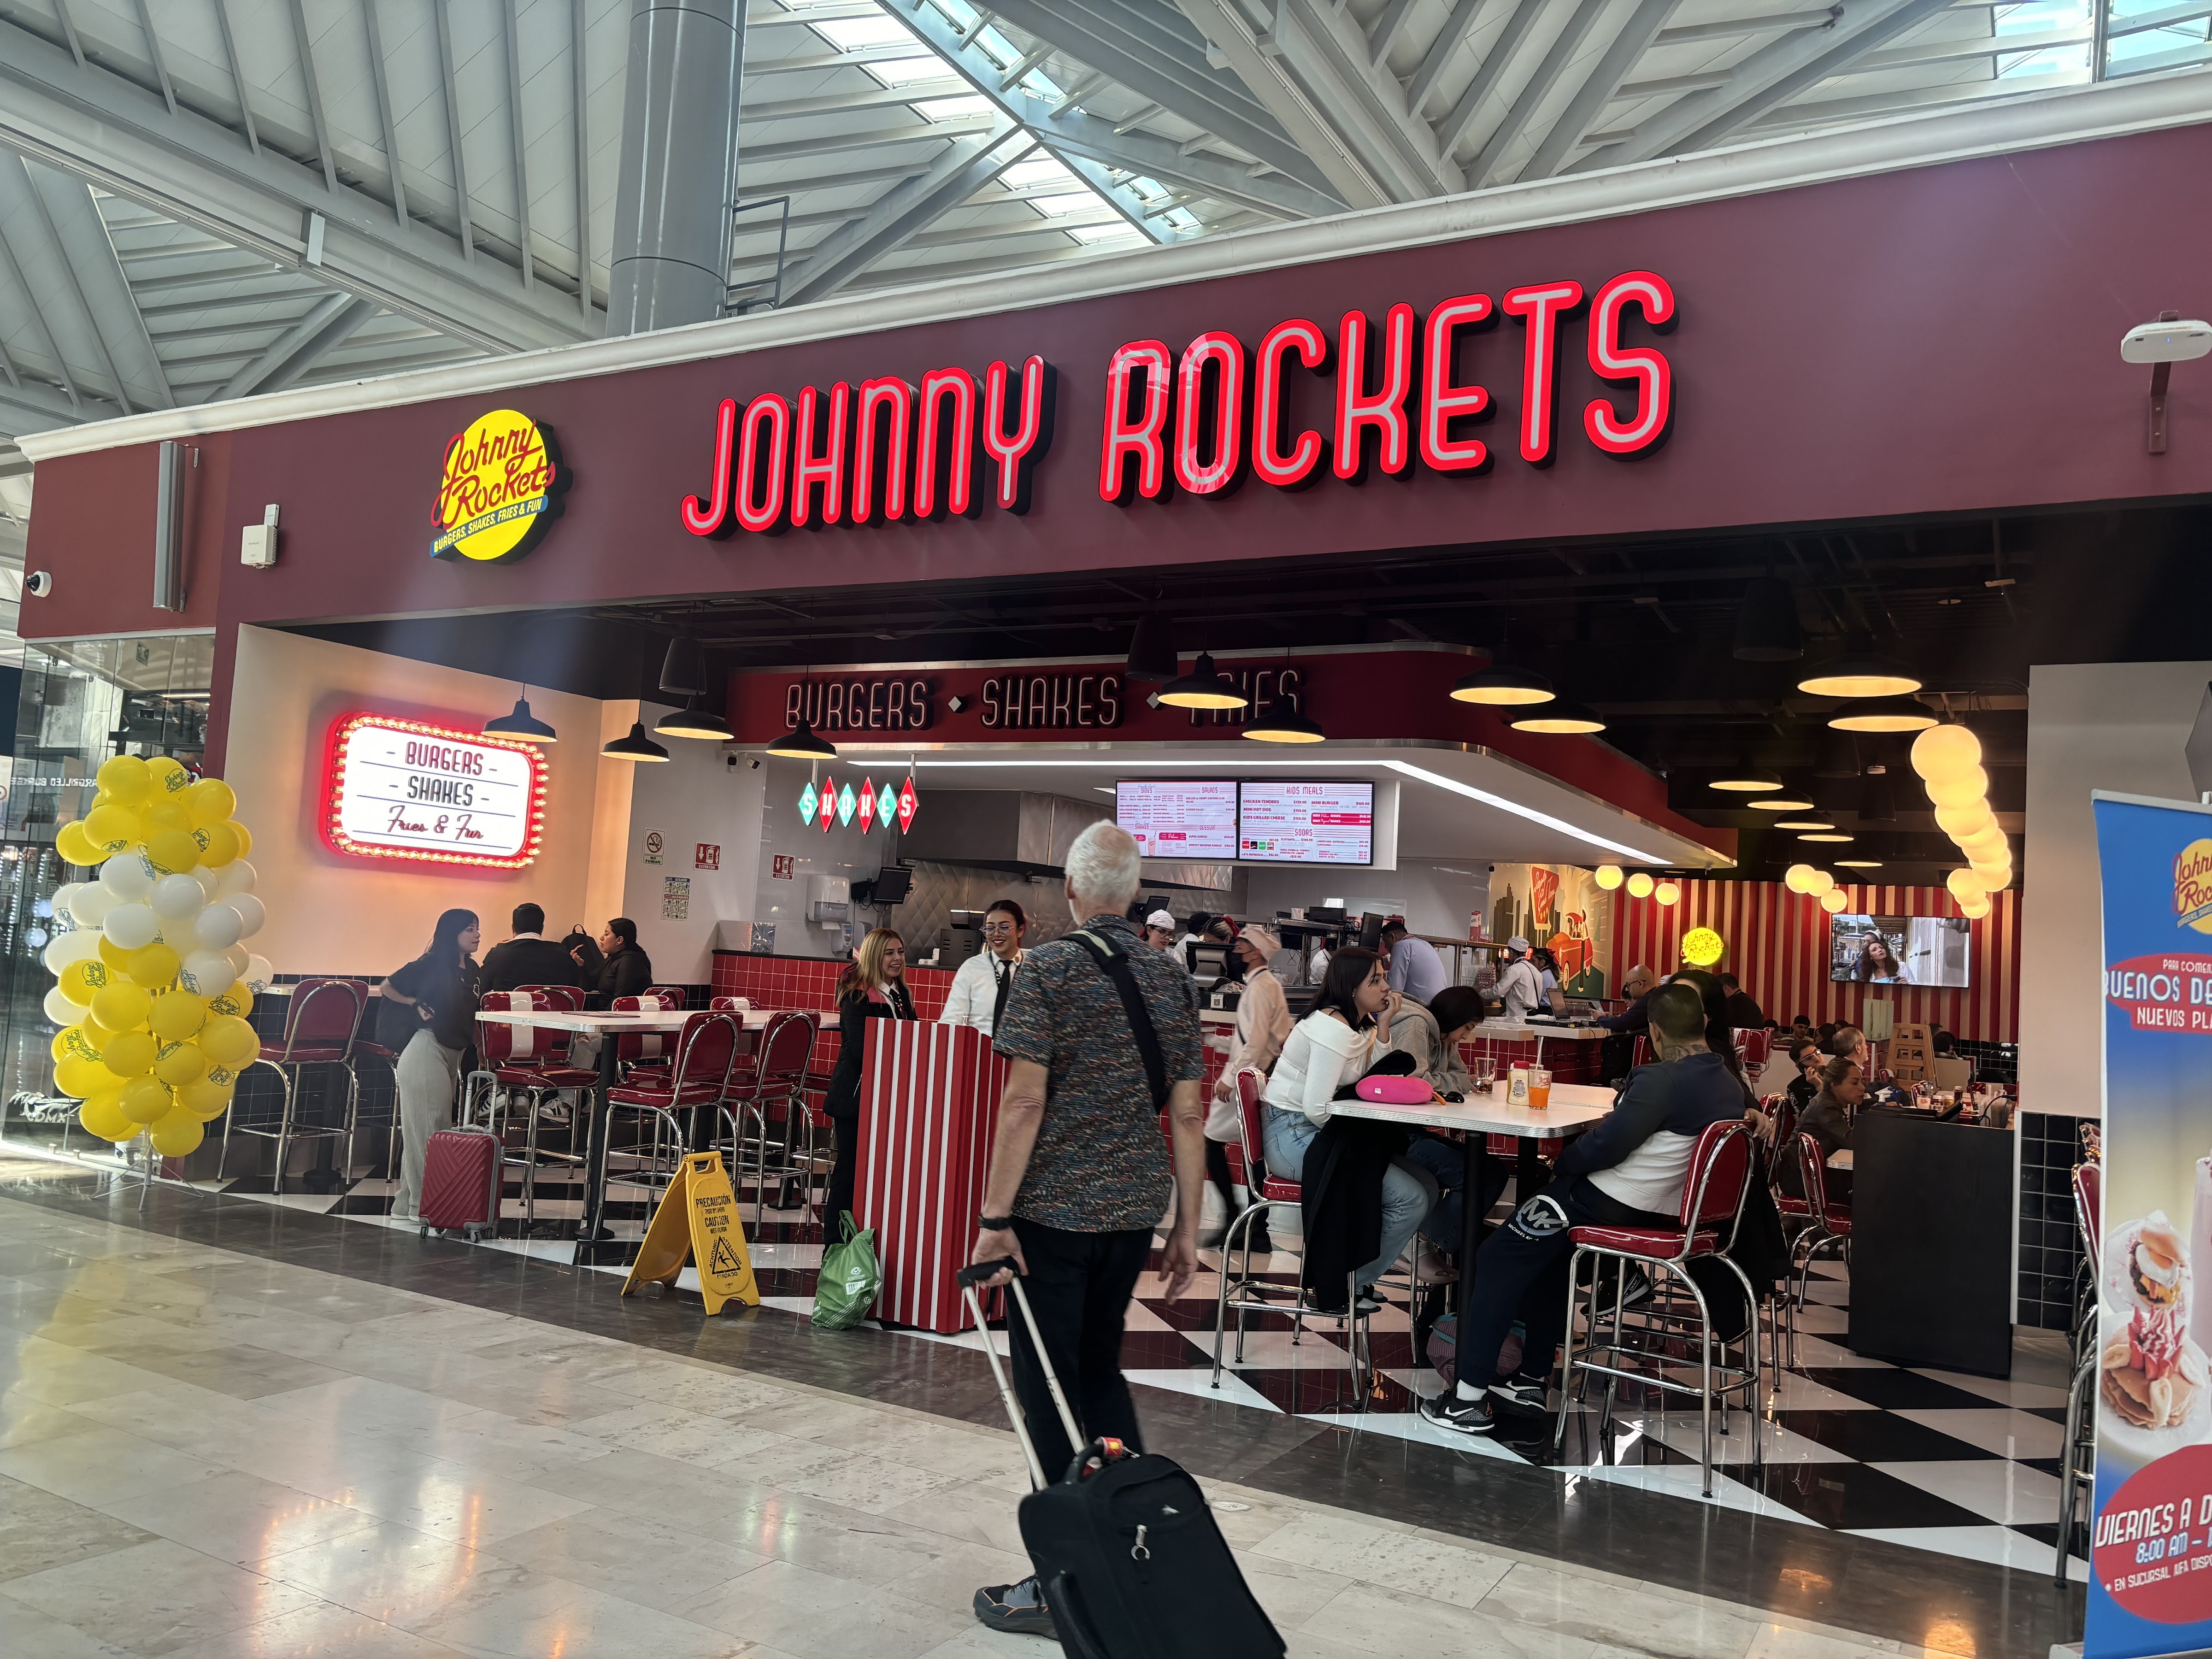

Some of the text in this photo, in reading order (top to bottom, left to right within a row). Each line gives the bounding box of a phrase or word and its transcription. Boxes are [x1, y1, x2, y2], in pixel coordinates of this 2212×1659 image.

[682, 271, 1674, 535] JOHNNY ROCKETS
[431, 418, 542, 527] Johnny
[443, 456, 556, 529] Rockets
[434, 499, 542, 553] BURGERS, SHAKES, FRIES & FUN
[786, 680, 928, 729] BURGERS
[981, 676, 1119, 729] SHAKES
[405, 741, 484, 776] BURGERS
[407, 776, 474, 806] SHAKES
[1286, 786, 1300, 794] KIDS
[803, 793, 912, 818] SHAKES
[388, 805, 484, 840] Fries & Fun
[1680, 933, 1717, 957] Johnny
[2181, 961, 2212, 974] COMEN
[2137, 1007, 2185, 1027] NUEVOS
[695, 1193, 731, 1208] PRECAUCIÓN
[705, 1215, 729, 1228] CAUTION
[1508, 1223, 1526, 1238] MICHAEL
[709, 1239, 718, 1269] ACHTUNG
[722, 1236, 742, 1265] ATTENTION
[2095, 1503, 2175, 1548] VIERNES
[2179, 1497, 2192, 1530] A
[2136, 1537, 2166, 1565] 8:00
[2168, 1531, 2189, 1557] AM
[2114, 1577, 2126, 1592] EN
[2128, 1566, 2171, 1588] SUCURSAL
[2173, 1559, 2189, 1577] AIFA
